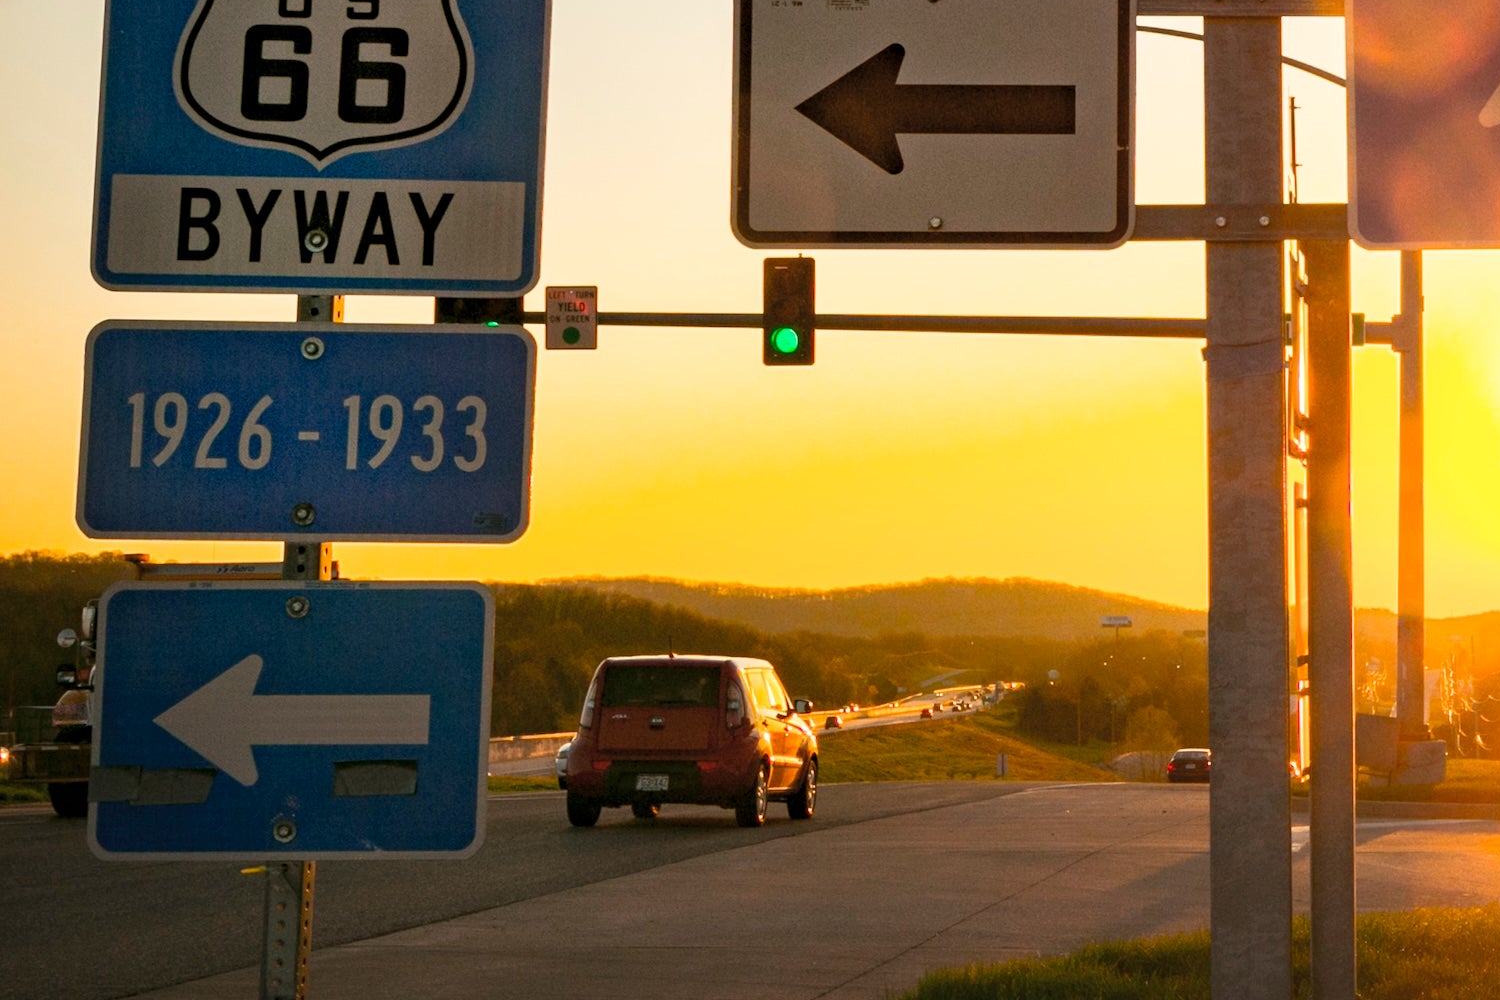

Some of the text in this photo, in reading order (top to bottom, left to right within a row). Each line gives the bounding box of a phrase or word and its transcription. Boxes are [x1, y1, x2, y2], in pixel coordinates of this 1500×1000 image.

[240, 24, 409, 124] 66
[176, 186, 455, 266] BYWAY
[548, 291, 594, 299] LEFT TURN
[558, 302, 585, 312] YIELD
[566, 315, 590, 323] GREEN
[127, 392, 274, 470] 1926
[343, 394, 488, 472] 1933
